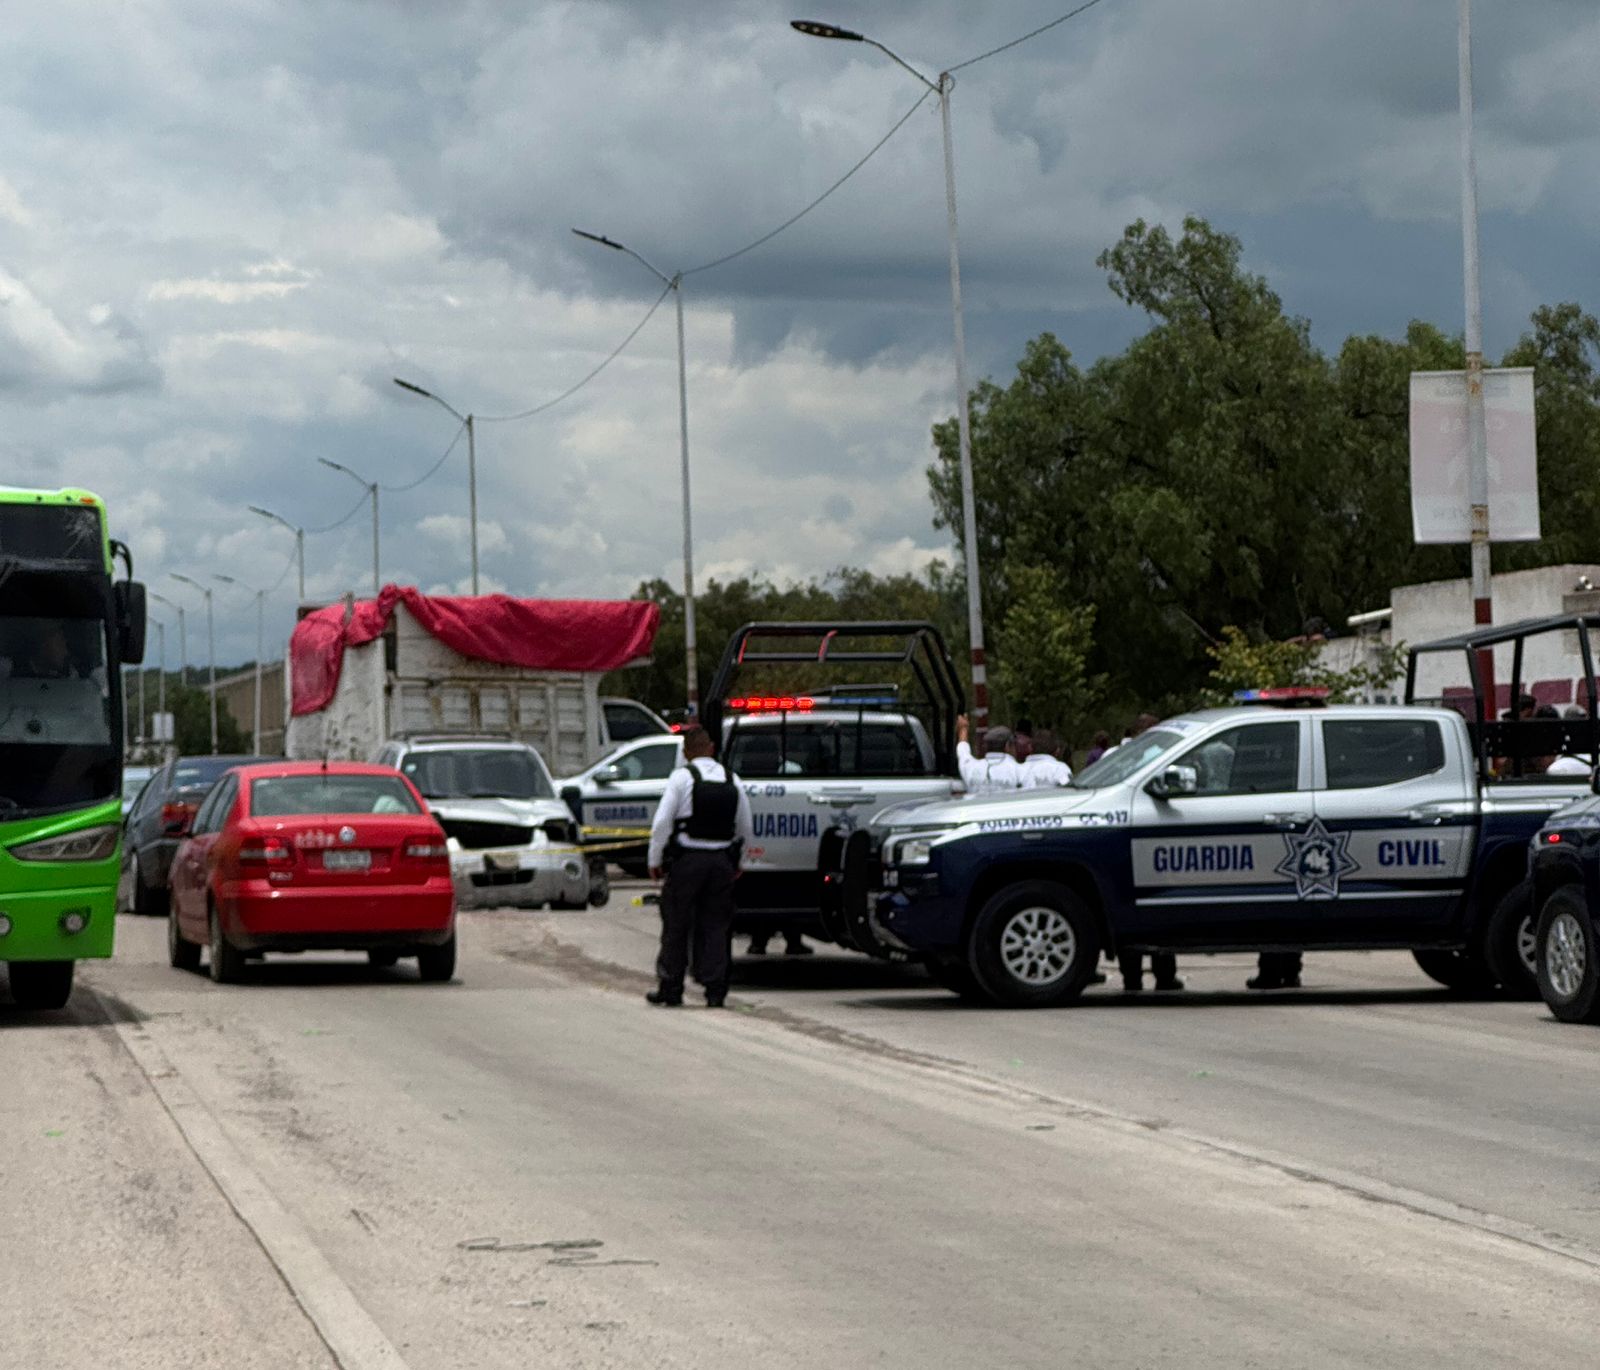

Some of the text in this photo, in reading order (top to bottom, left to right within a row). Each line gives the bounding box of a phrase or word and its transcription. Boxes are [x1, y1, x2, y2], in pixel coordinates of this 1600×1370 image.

[752, 814, 818, 837] UARDIA
[1153, 839, 1446, 872] GUARDIA CIVIL
